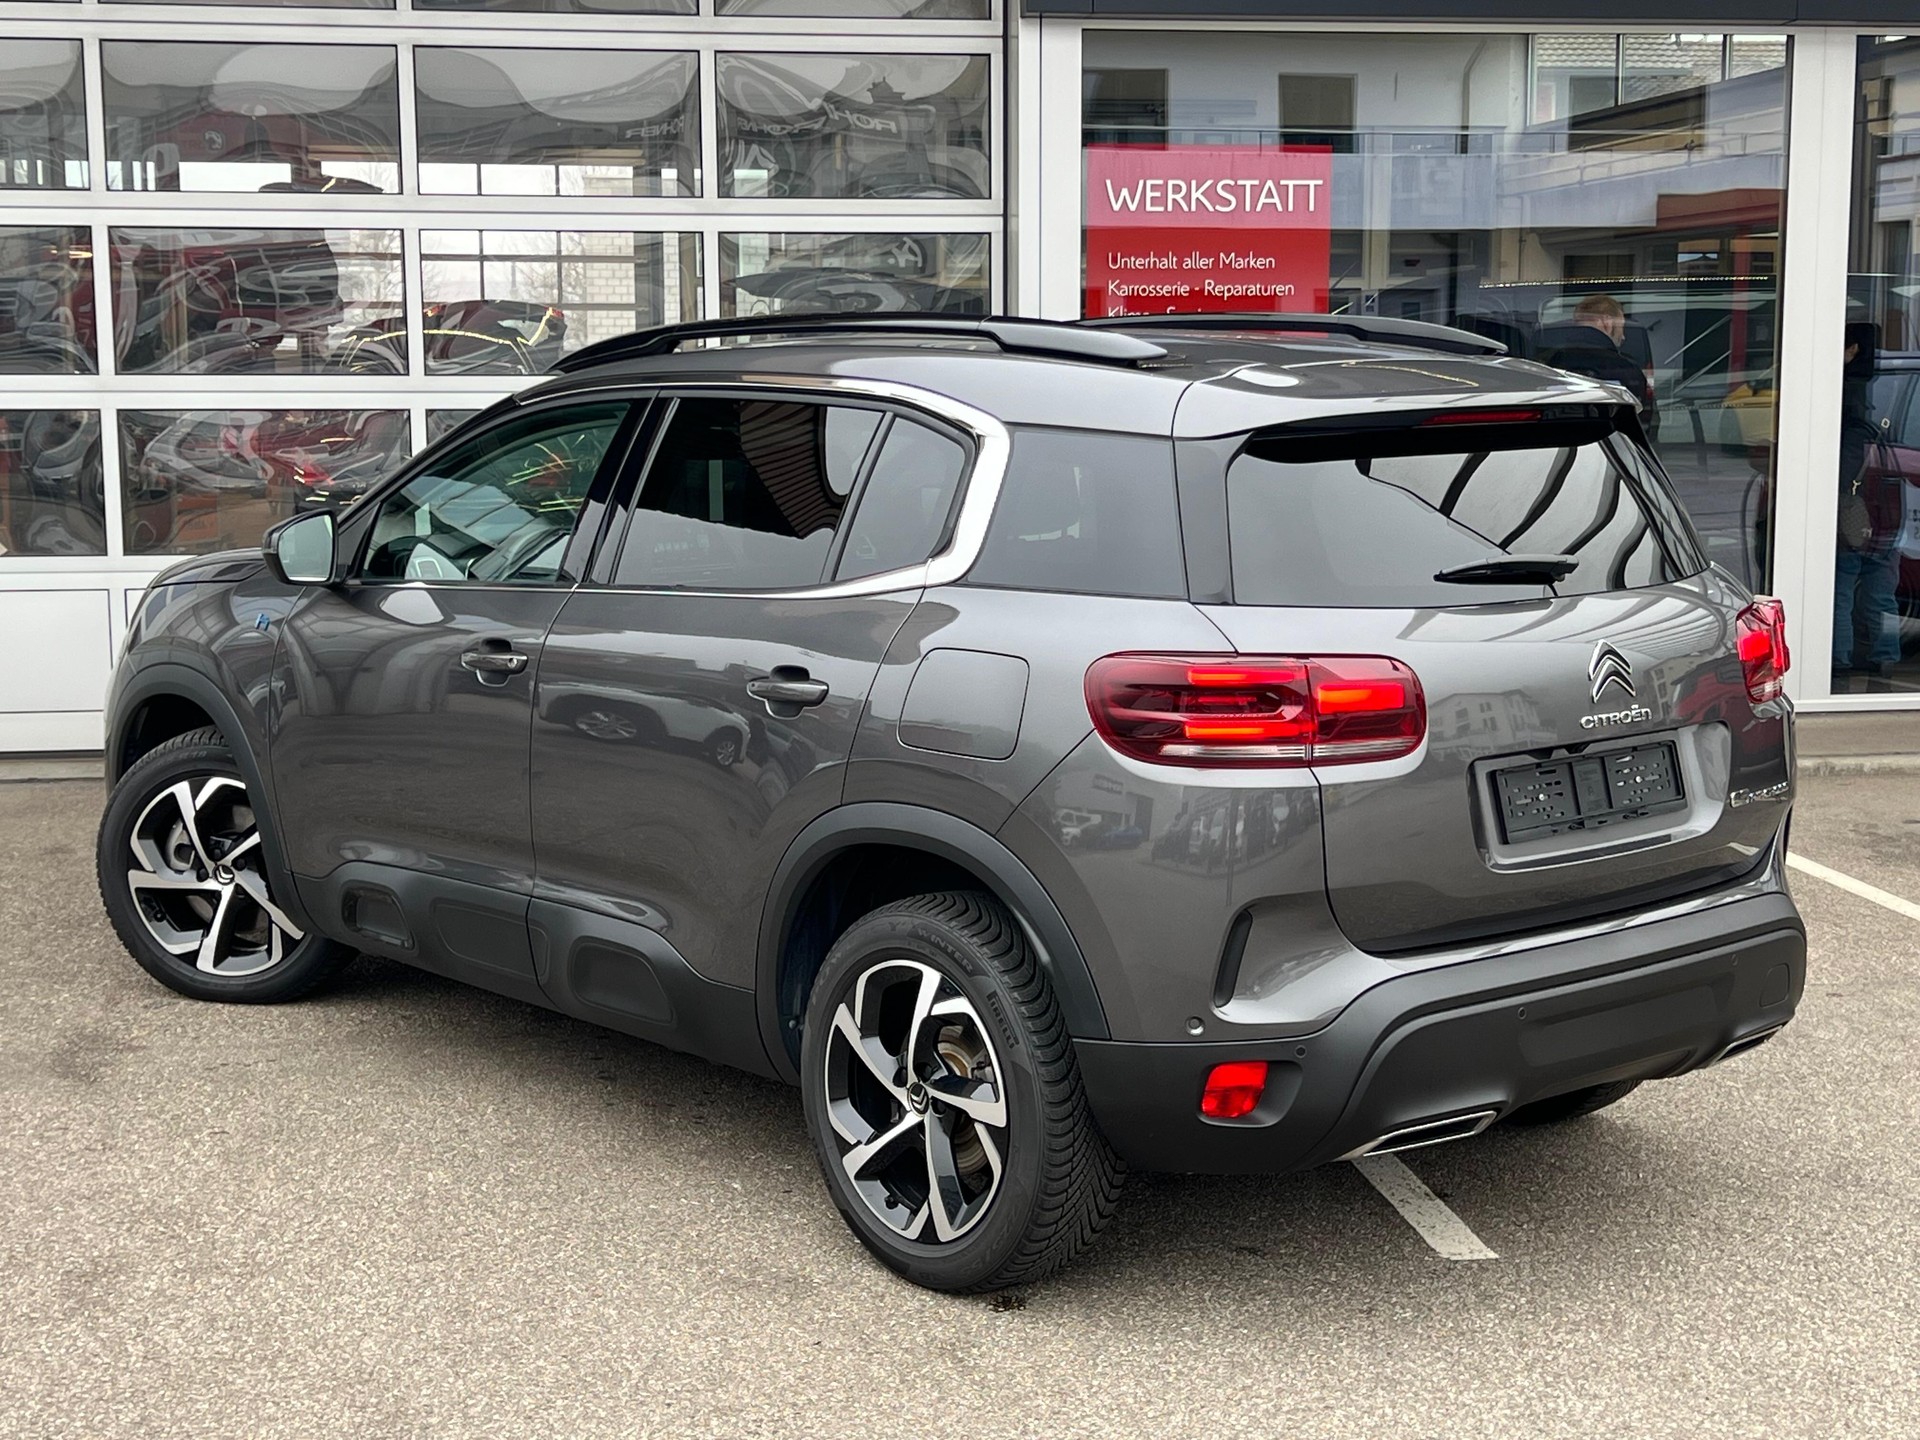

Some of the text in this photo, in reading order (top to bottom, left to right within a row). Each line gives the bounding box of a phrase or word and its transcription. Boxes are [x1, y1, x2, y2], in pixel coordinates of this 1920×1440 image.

[1105, 179, 1323, 212] WERKSTATT
[1108, 251, 1276, 270] Unterhalt aller Marken
[1108, 280, 1190, 297] Karrosserie
[1204, 279, 1295, 301] Reparaturen
[1107, 305, 1150, 318] Kli
[916, 927, 974, 974] WINTER
[986, 989, 1020, 1050] PIRELLI
